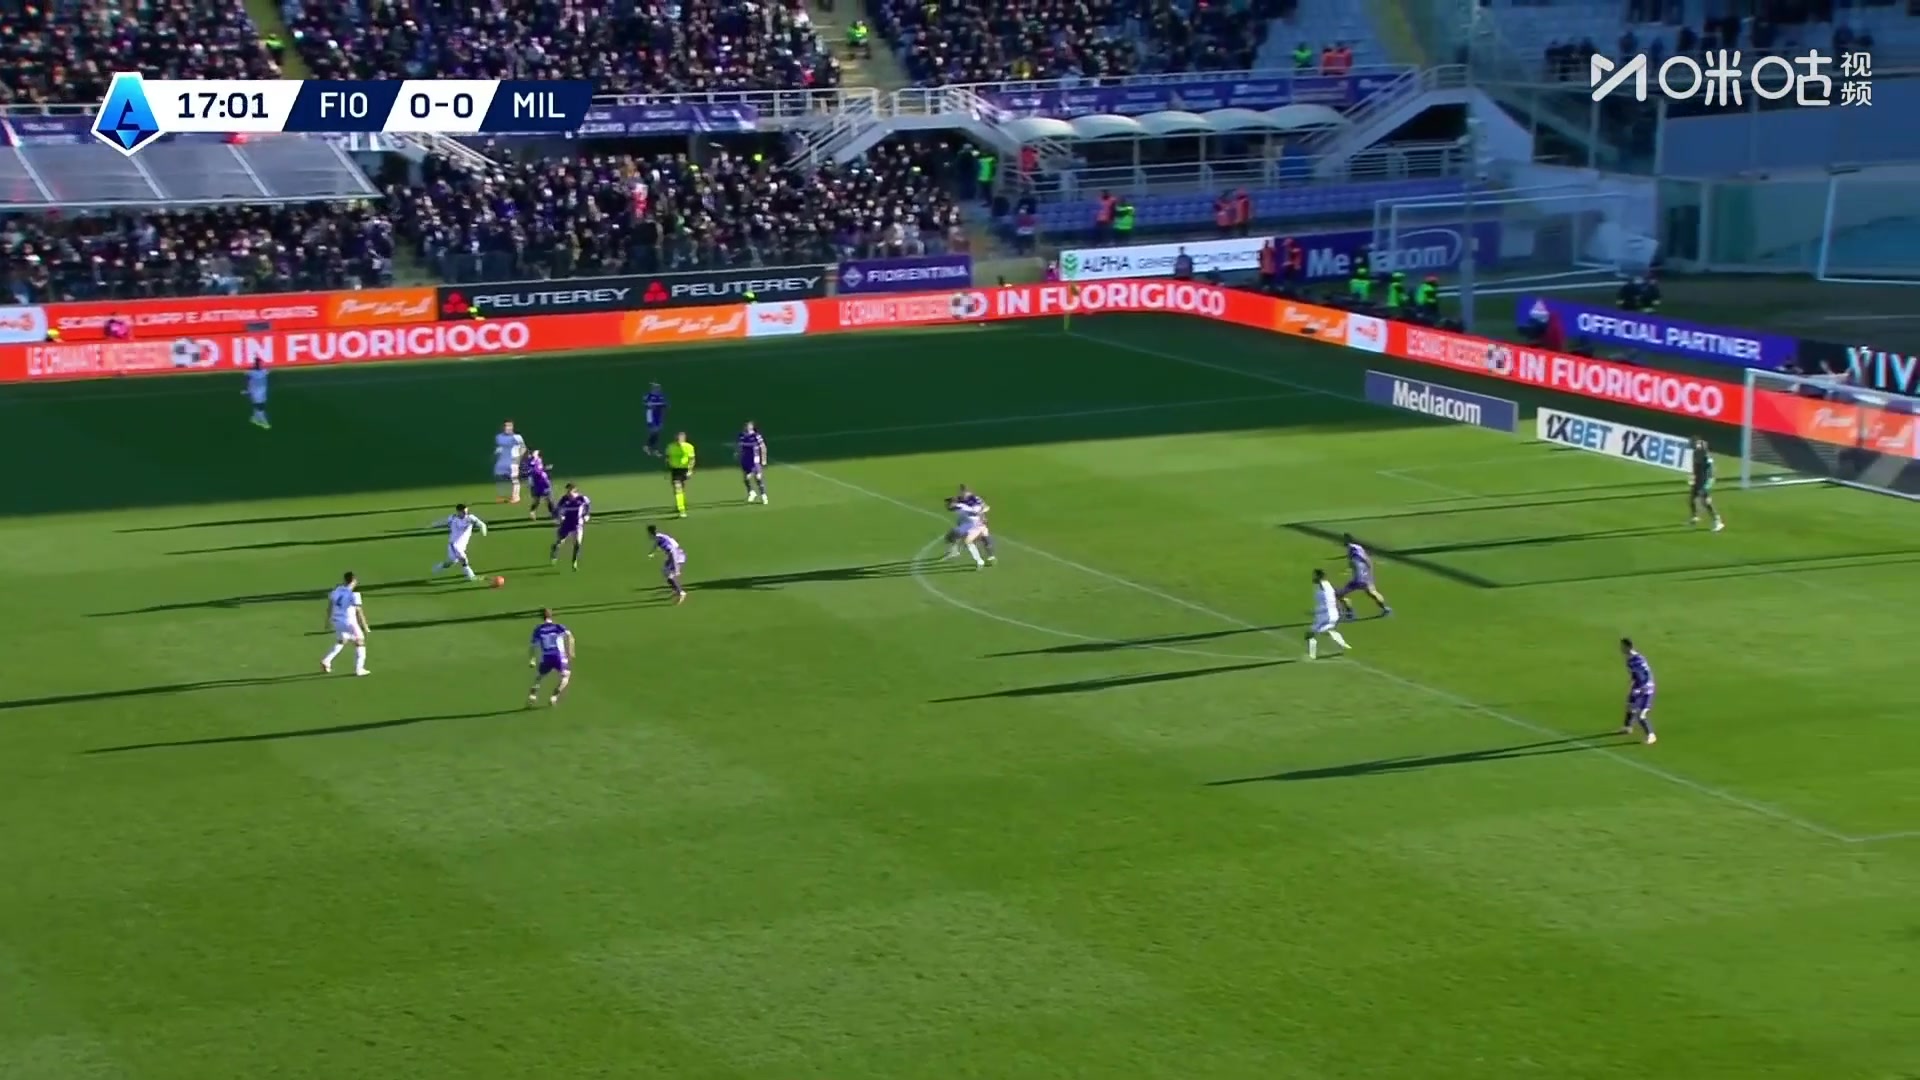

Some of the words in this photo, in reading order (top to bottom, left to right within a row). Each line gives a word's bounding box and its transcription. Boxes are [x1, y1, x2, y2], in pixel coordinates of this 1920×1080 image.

[671, 275, 821, 298] PEUTEREY
[866, 264, 969, 283] FIORENTINA
[471, 287, 631, 309] PEUTEREY
[997, 288, 1030, 316] IN
[1039, 282, 1226, 317] FUORIGIOCO
[232, 333, 274, 366] IN
[286, 320, 530, 363] FUORIGIOCO
[1577, 311, 1664, 345] OFFICIAL
[1666, 327, 1762, 361] PARTNER
[1392, 379, 1482, 426] Mediacom
[1519, 350, 1546, 384] IN
[1552, 357, 1725, 417] FUORIGIOCO
[1545, 413, 1613, 450] 1XBET
[1621, 428, 1689, 466] 1XBET
